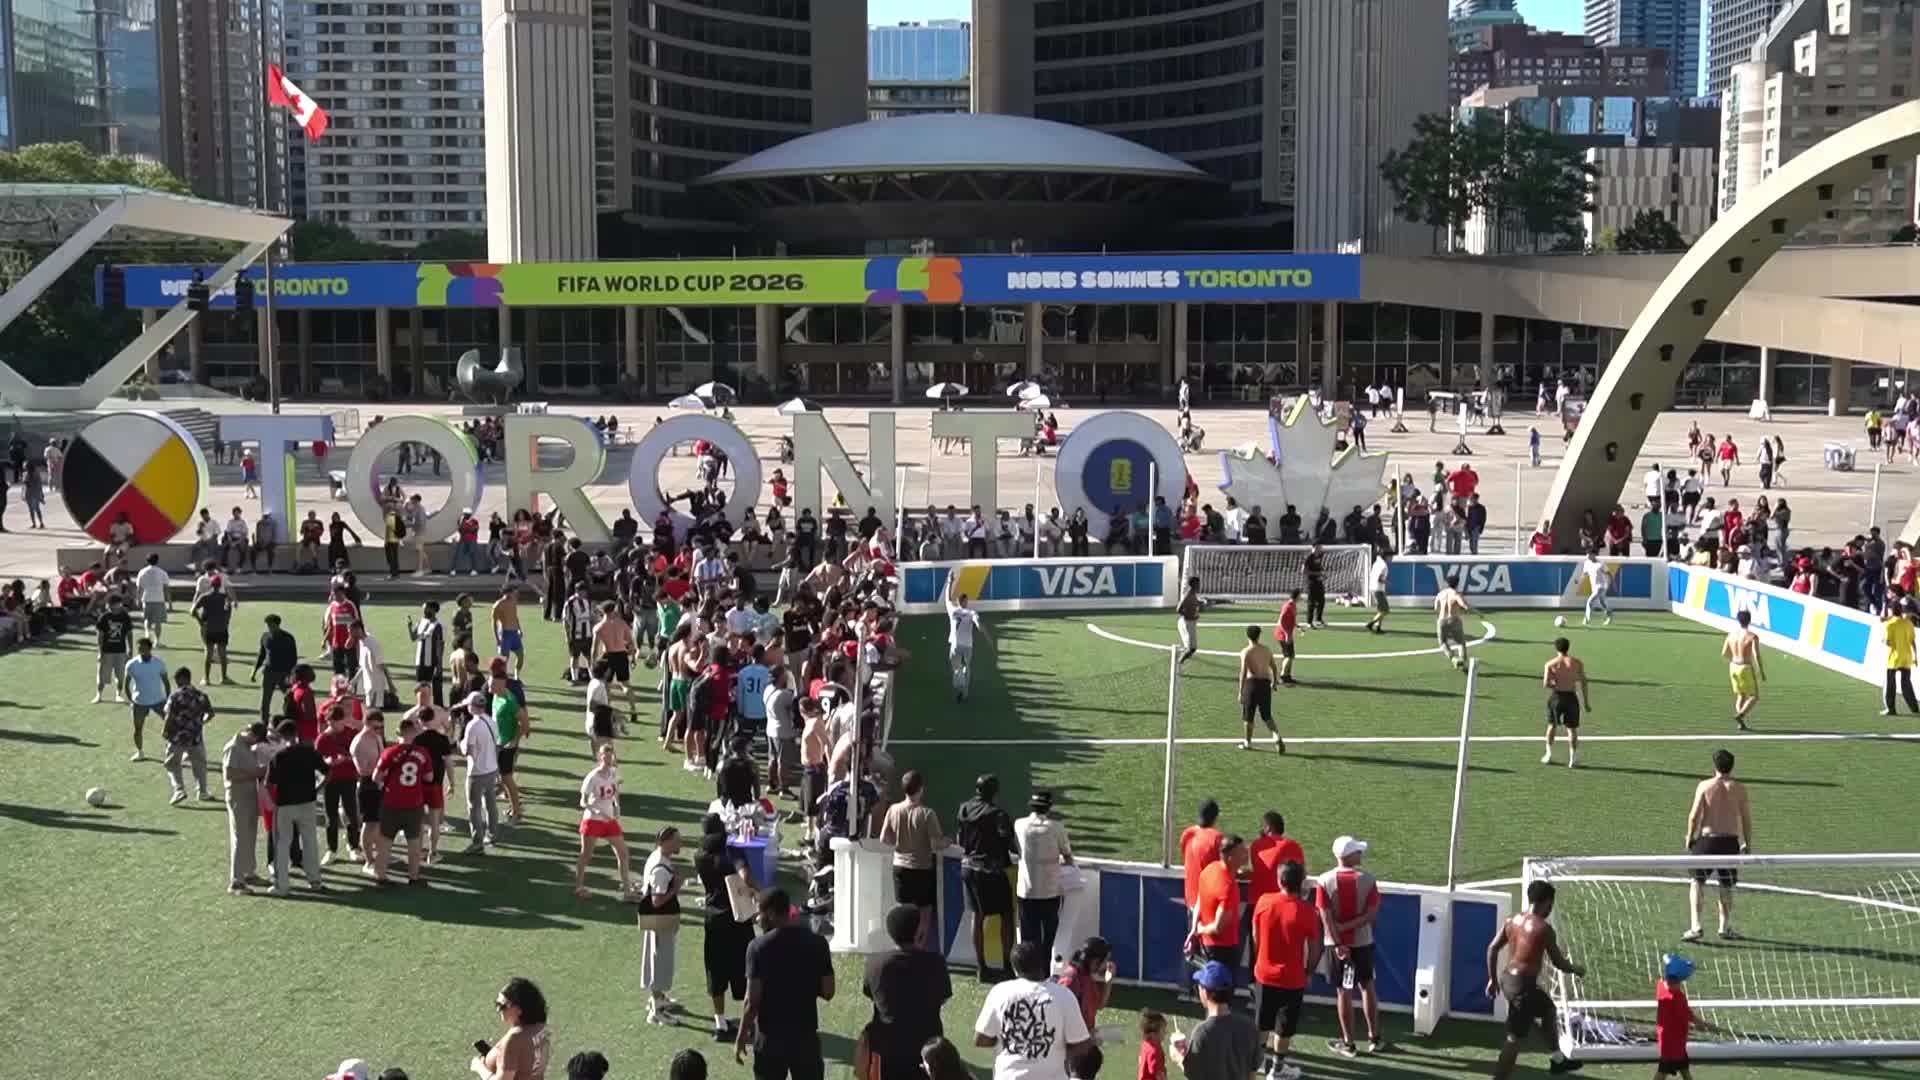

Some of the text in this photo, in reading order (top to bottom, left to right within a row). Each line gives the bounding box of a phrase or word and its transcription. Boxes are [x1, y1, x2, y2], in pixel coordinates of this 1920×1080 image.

[252, 278, 349, 295] ORONTO
[557, 274, 804, 292] FIFA WORLD CUP 2026
[1008, 269, 1312, 289] NOUS SOMMES TORONTO
[219, 409, 1187, 546] TORONTO
[1032, 566, 1117, 595] VISA
[1426, 564, 1512, 592] VISA
[746, 677, 761, 694] 31
[400, 762, 418, 786] 8
